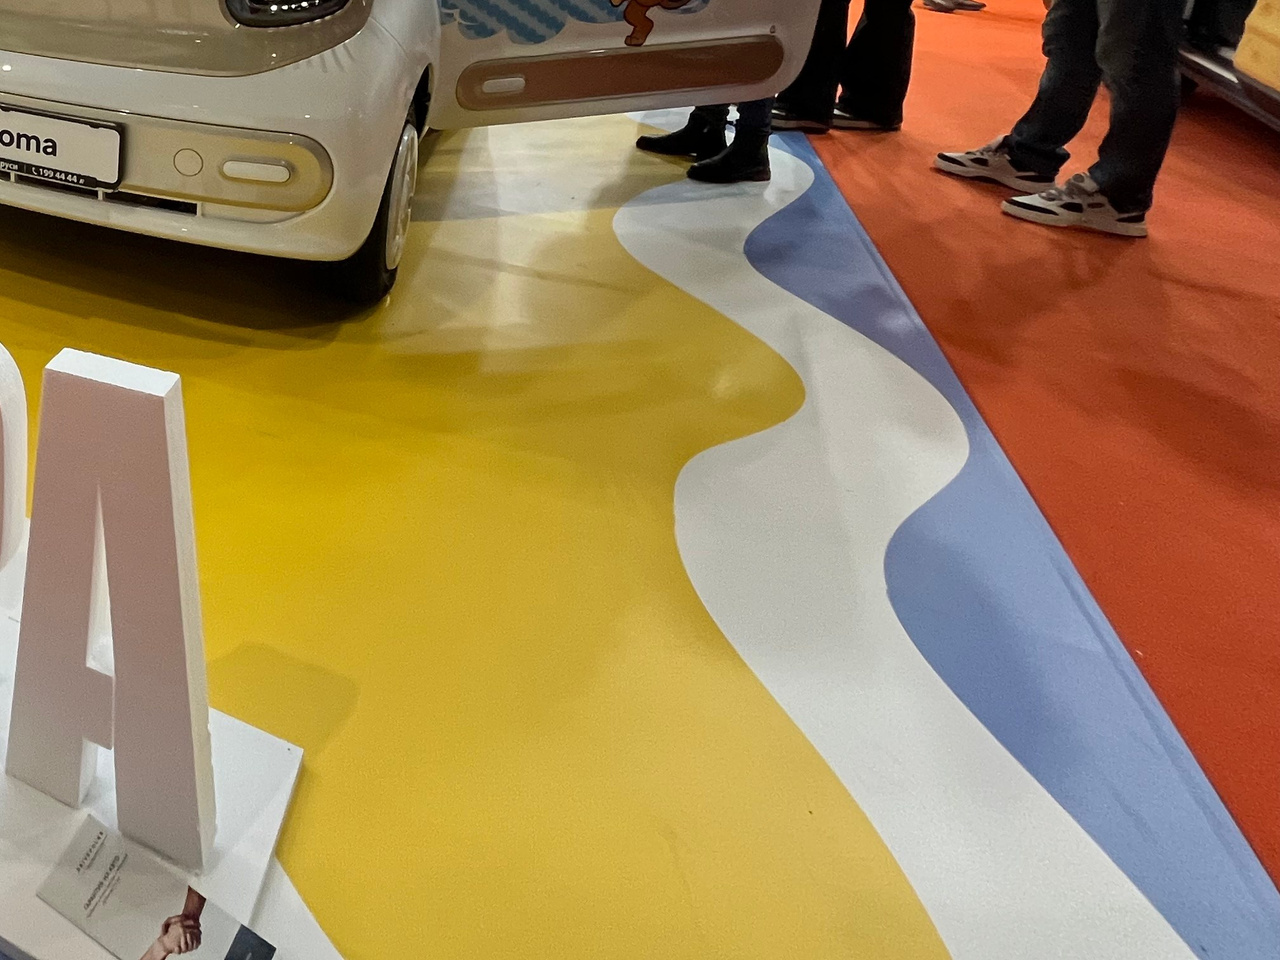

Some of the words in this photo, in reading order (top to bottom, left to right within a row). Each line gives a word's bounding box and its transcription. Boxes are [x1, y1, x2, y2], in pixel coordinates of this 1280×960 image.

[39, 168, 54, 178] 199
[55, 172, 66, 181] 44
[66, 174, 78, 183] 44
